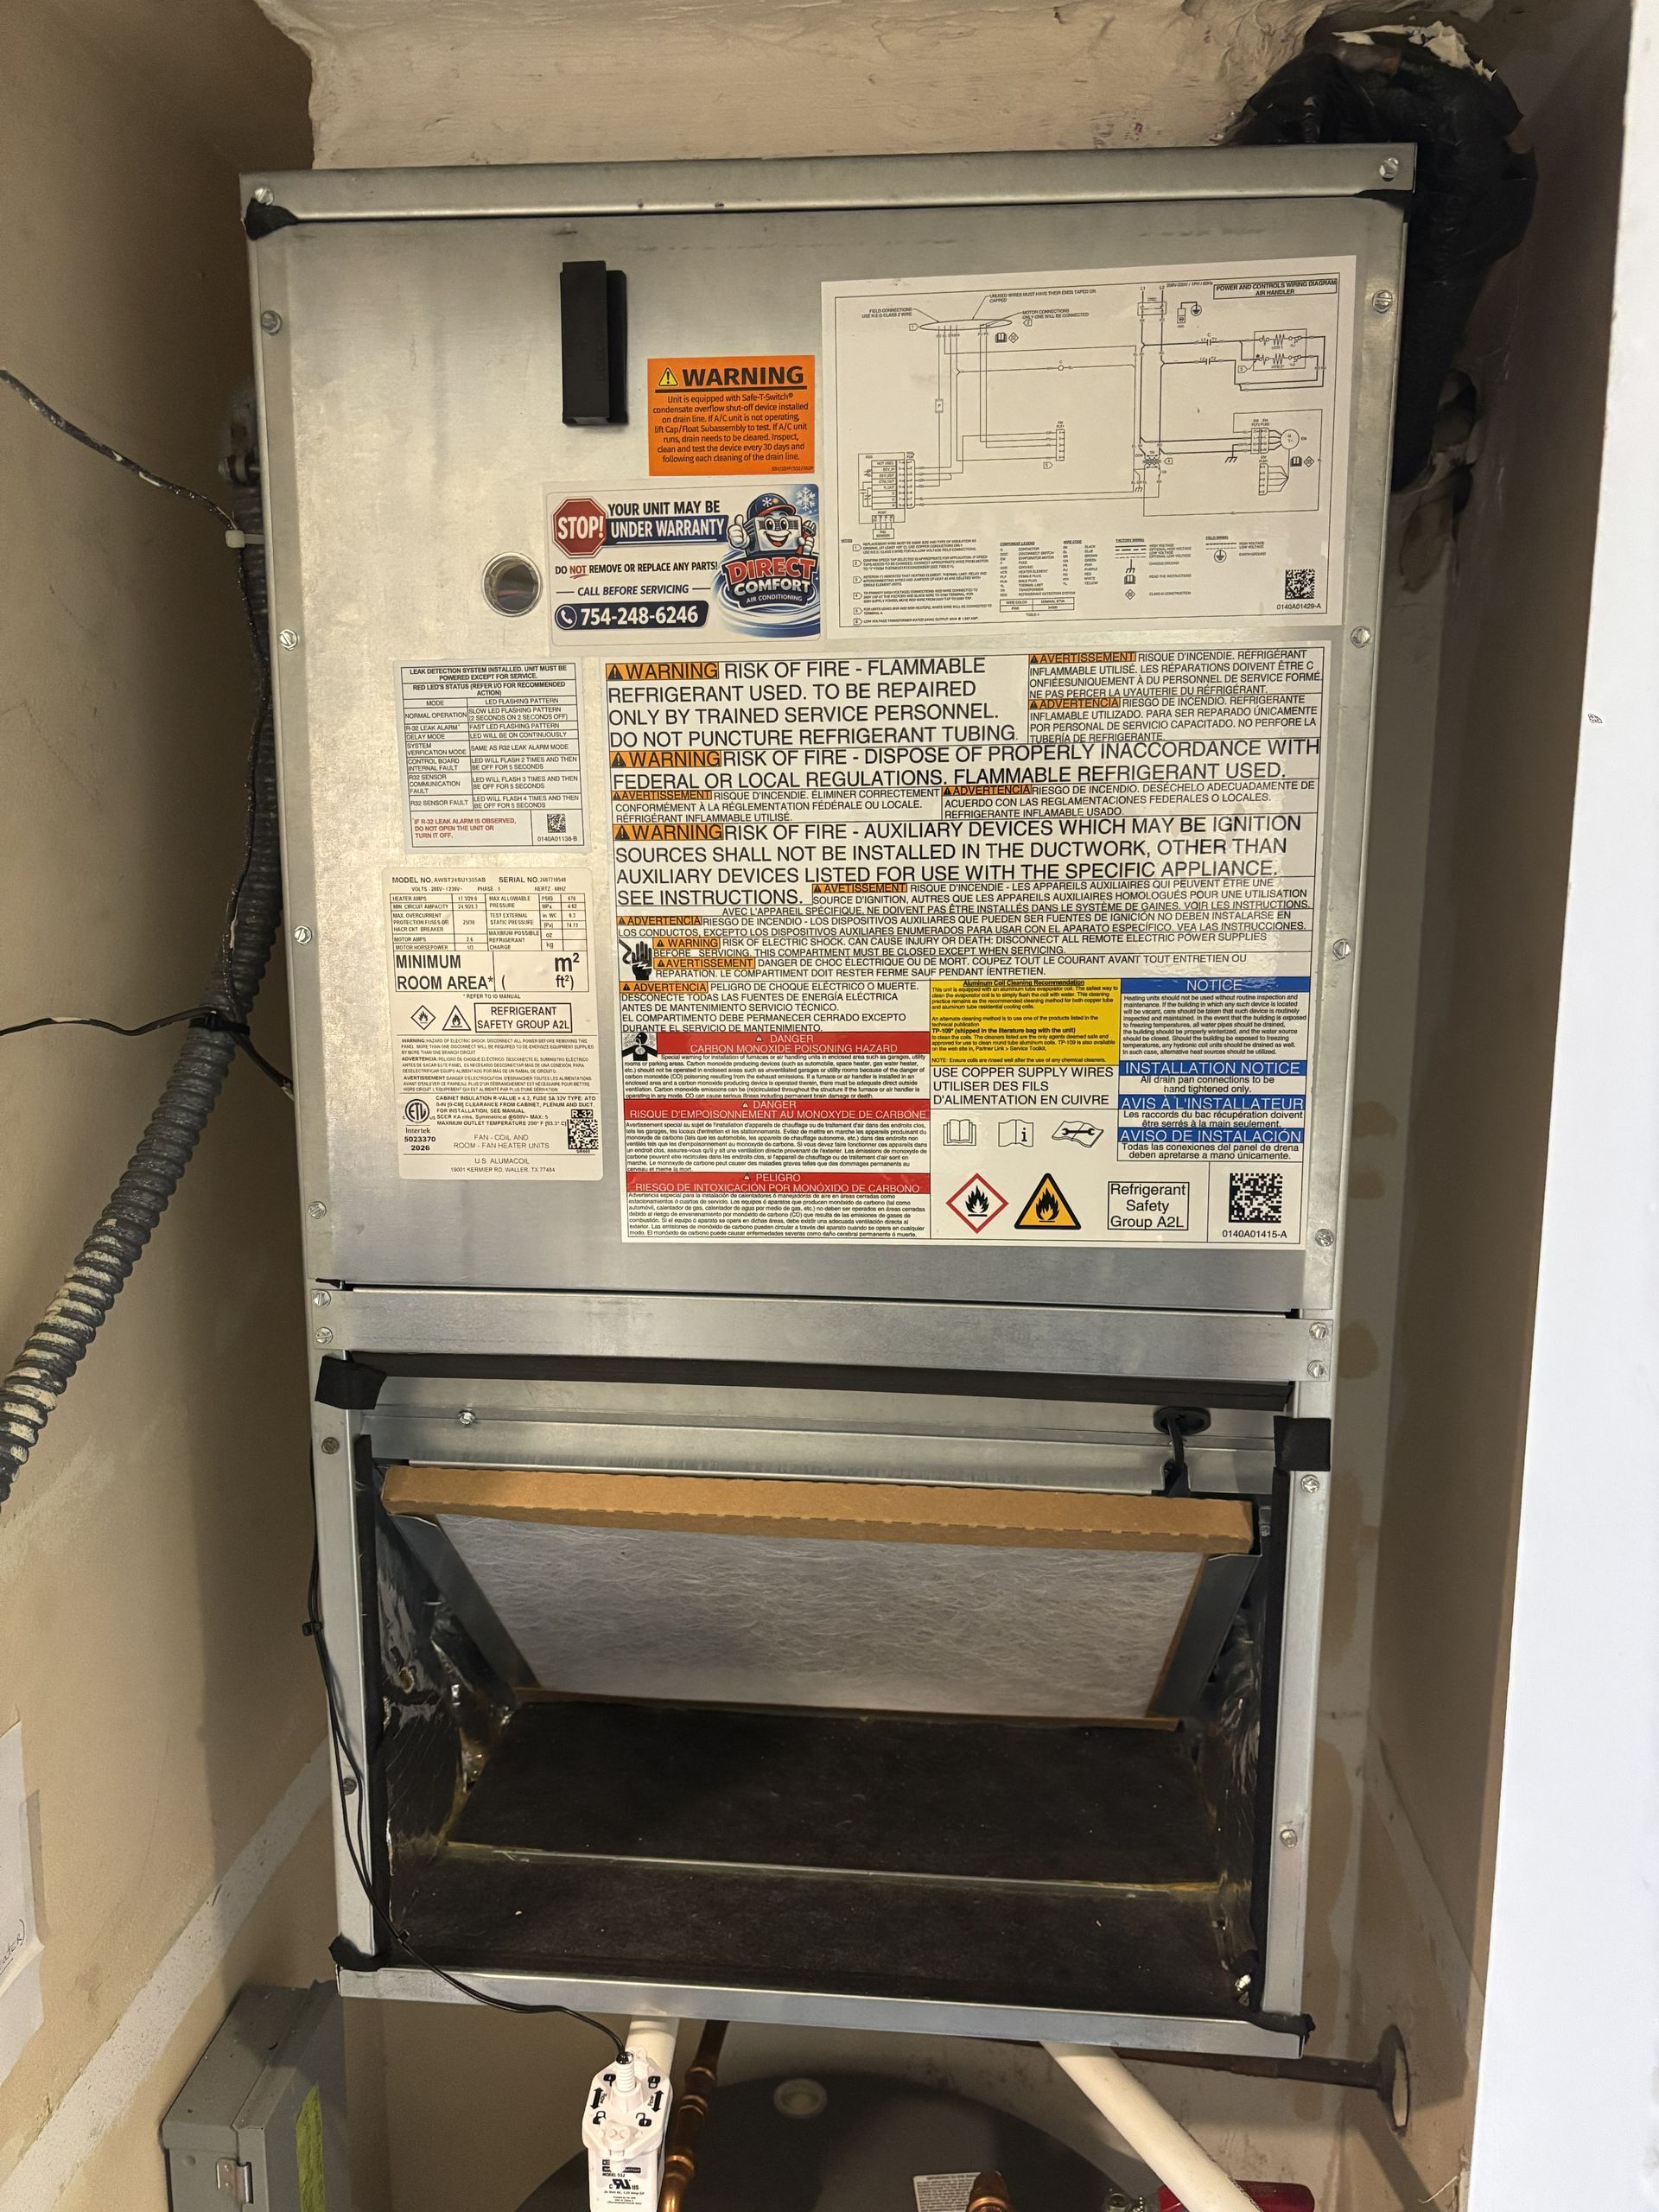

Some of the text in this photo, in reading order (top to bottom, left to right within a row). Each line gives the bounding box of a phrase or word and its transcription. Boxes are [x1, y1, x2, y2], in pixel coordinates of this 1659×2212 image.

[682, 365, 804, 387] WARNING
[667, 395, 682, 404] Unit
[690, 394, 724, 404] equipped
[663, 454, 694, 463] following
[713, 454, 742, 462] cleaning
[608, 500, 720, 517] YOUR UNIT MAY BE
[557, 515, 604, 539] STOP!
[611, 518, 725, 538] UNDER WARRANTY
[555, 562, 718, 575] DO NOT REMOVE OR REPLACE ANY PARTS!
[728, 556, 816, 583] DIRECT
[577, 584, 689, 596] CALL BEFORE SERVICING
[734, 578, 811, 596] COMFORT
[758, 594, 803, 603] CONDITIONING
[581, 606, 698, 626] 754-248-6246
[1039, 652, 1135, 664] AVERTISSEMENT
[1137, 652, 1174, 662] RISQUE
[626, 662, 718, 679] WARNING
[724, 662, 769, 678] RISK
[773, 661, 801, 677] OF
[807, 660, 850, 677] FIRE
[868, 657, 986, 676] FLAMMABLE
[608, 680, 976, 703] REFRIGERANT USED. TO BE REPAIRED
[608, 702, 998, 726] ONLY BY TRAINED SERVICE PERSONNEL.
[610, 725, 1018, 747] DO NOT PUNCTURE REFRIGERANT TUBING.
[613, 761, 1286, 790] FEDERAL OR LOCAL REGULATIONS. FLAMMABLE REFRIGERANT USED.
[615, 837, 1287, 863] SOURCES SHALL NOT BE INSTALLED IN THE DUCTWORK, OTHER THAN
[617, 888, 804, 906] SEE INSTRUCTIONS.
[396, 955, 461, 969] MINIMUM
[397, 976, 442, 990] ROOM
[633, 980, 919, 992] ADVERTENCIA PELIGRO DE CHOQUE ELÉCTRICO O MUERTE.
[1186, 979, 1243, 991] NOTICE
[491, 1006, 556, 1016] REFRIGERANT
[477, 1020, 570, 1029] SAFETY GROUP A2L
[770, 1034, 814, 1043] DANGER
[690, 1044, 898, 1053] CARBON MONOXIDE POISONING HAZARD
[932, 1066, 1114, 1077] USE COPPER SUPPLY WIRES
[1125, 1062, 1300, 1075] INSTALLATION NOTICE
[1197, 1075, 1249, 1084] connections
[1252, 1075, 1261, 1084] to
[1262, 1075, 1275, 1084] be
[1163, 1084, 1252, 1095] hand tightened only.
[1122, 1098, 1155, 1109] AVIS
[1120, 1128, 1302, 1142] AVISO DE INSTALACIÓN
[1110, 1184, 1186, 1198] Refrigerant
[1126, 1199, 1170, 1213] Safety
[1110, 1215, 1185, 1229] Group A2L
[1222, 1230, 1287, 1238] 0140A01415-A
